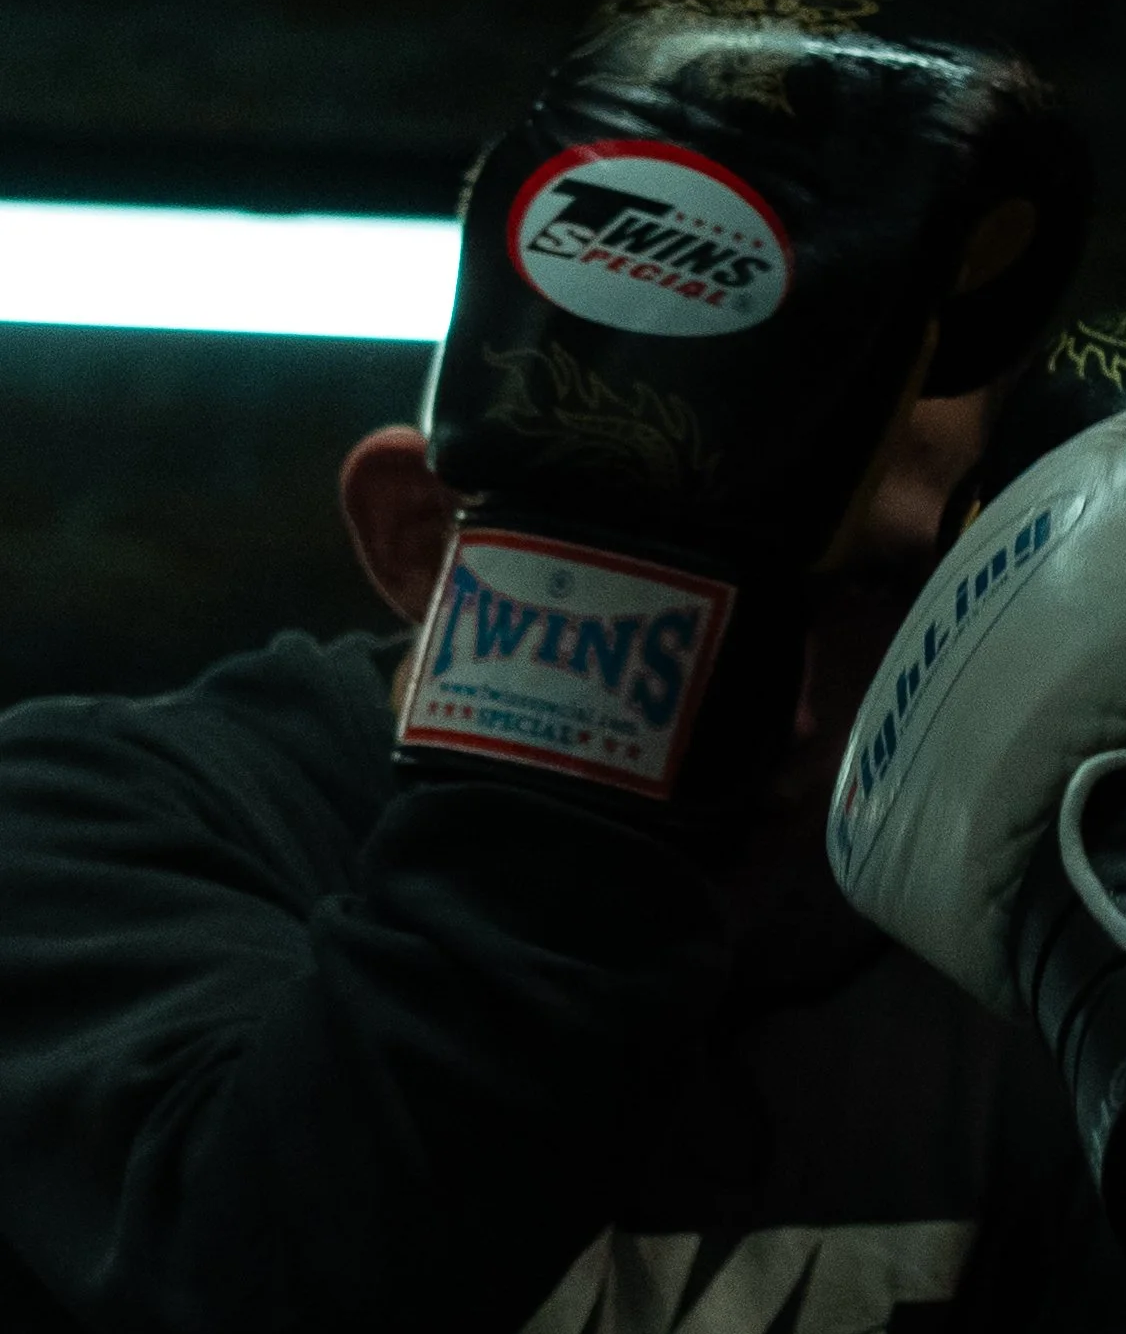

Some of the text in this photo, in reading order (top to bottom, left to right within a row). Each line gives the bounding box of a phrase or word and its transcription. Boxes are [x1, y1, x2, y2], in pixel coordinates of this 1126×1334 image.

[528, 178, 773, 289] TWINS
[528, 218, 728, 308] SPECIAL
[432, 565, 703, 727] TWINS
